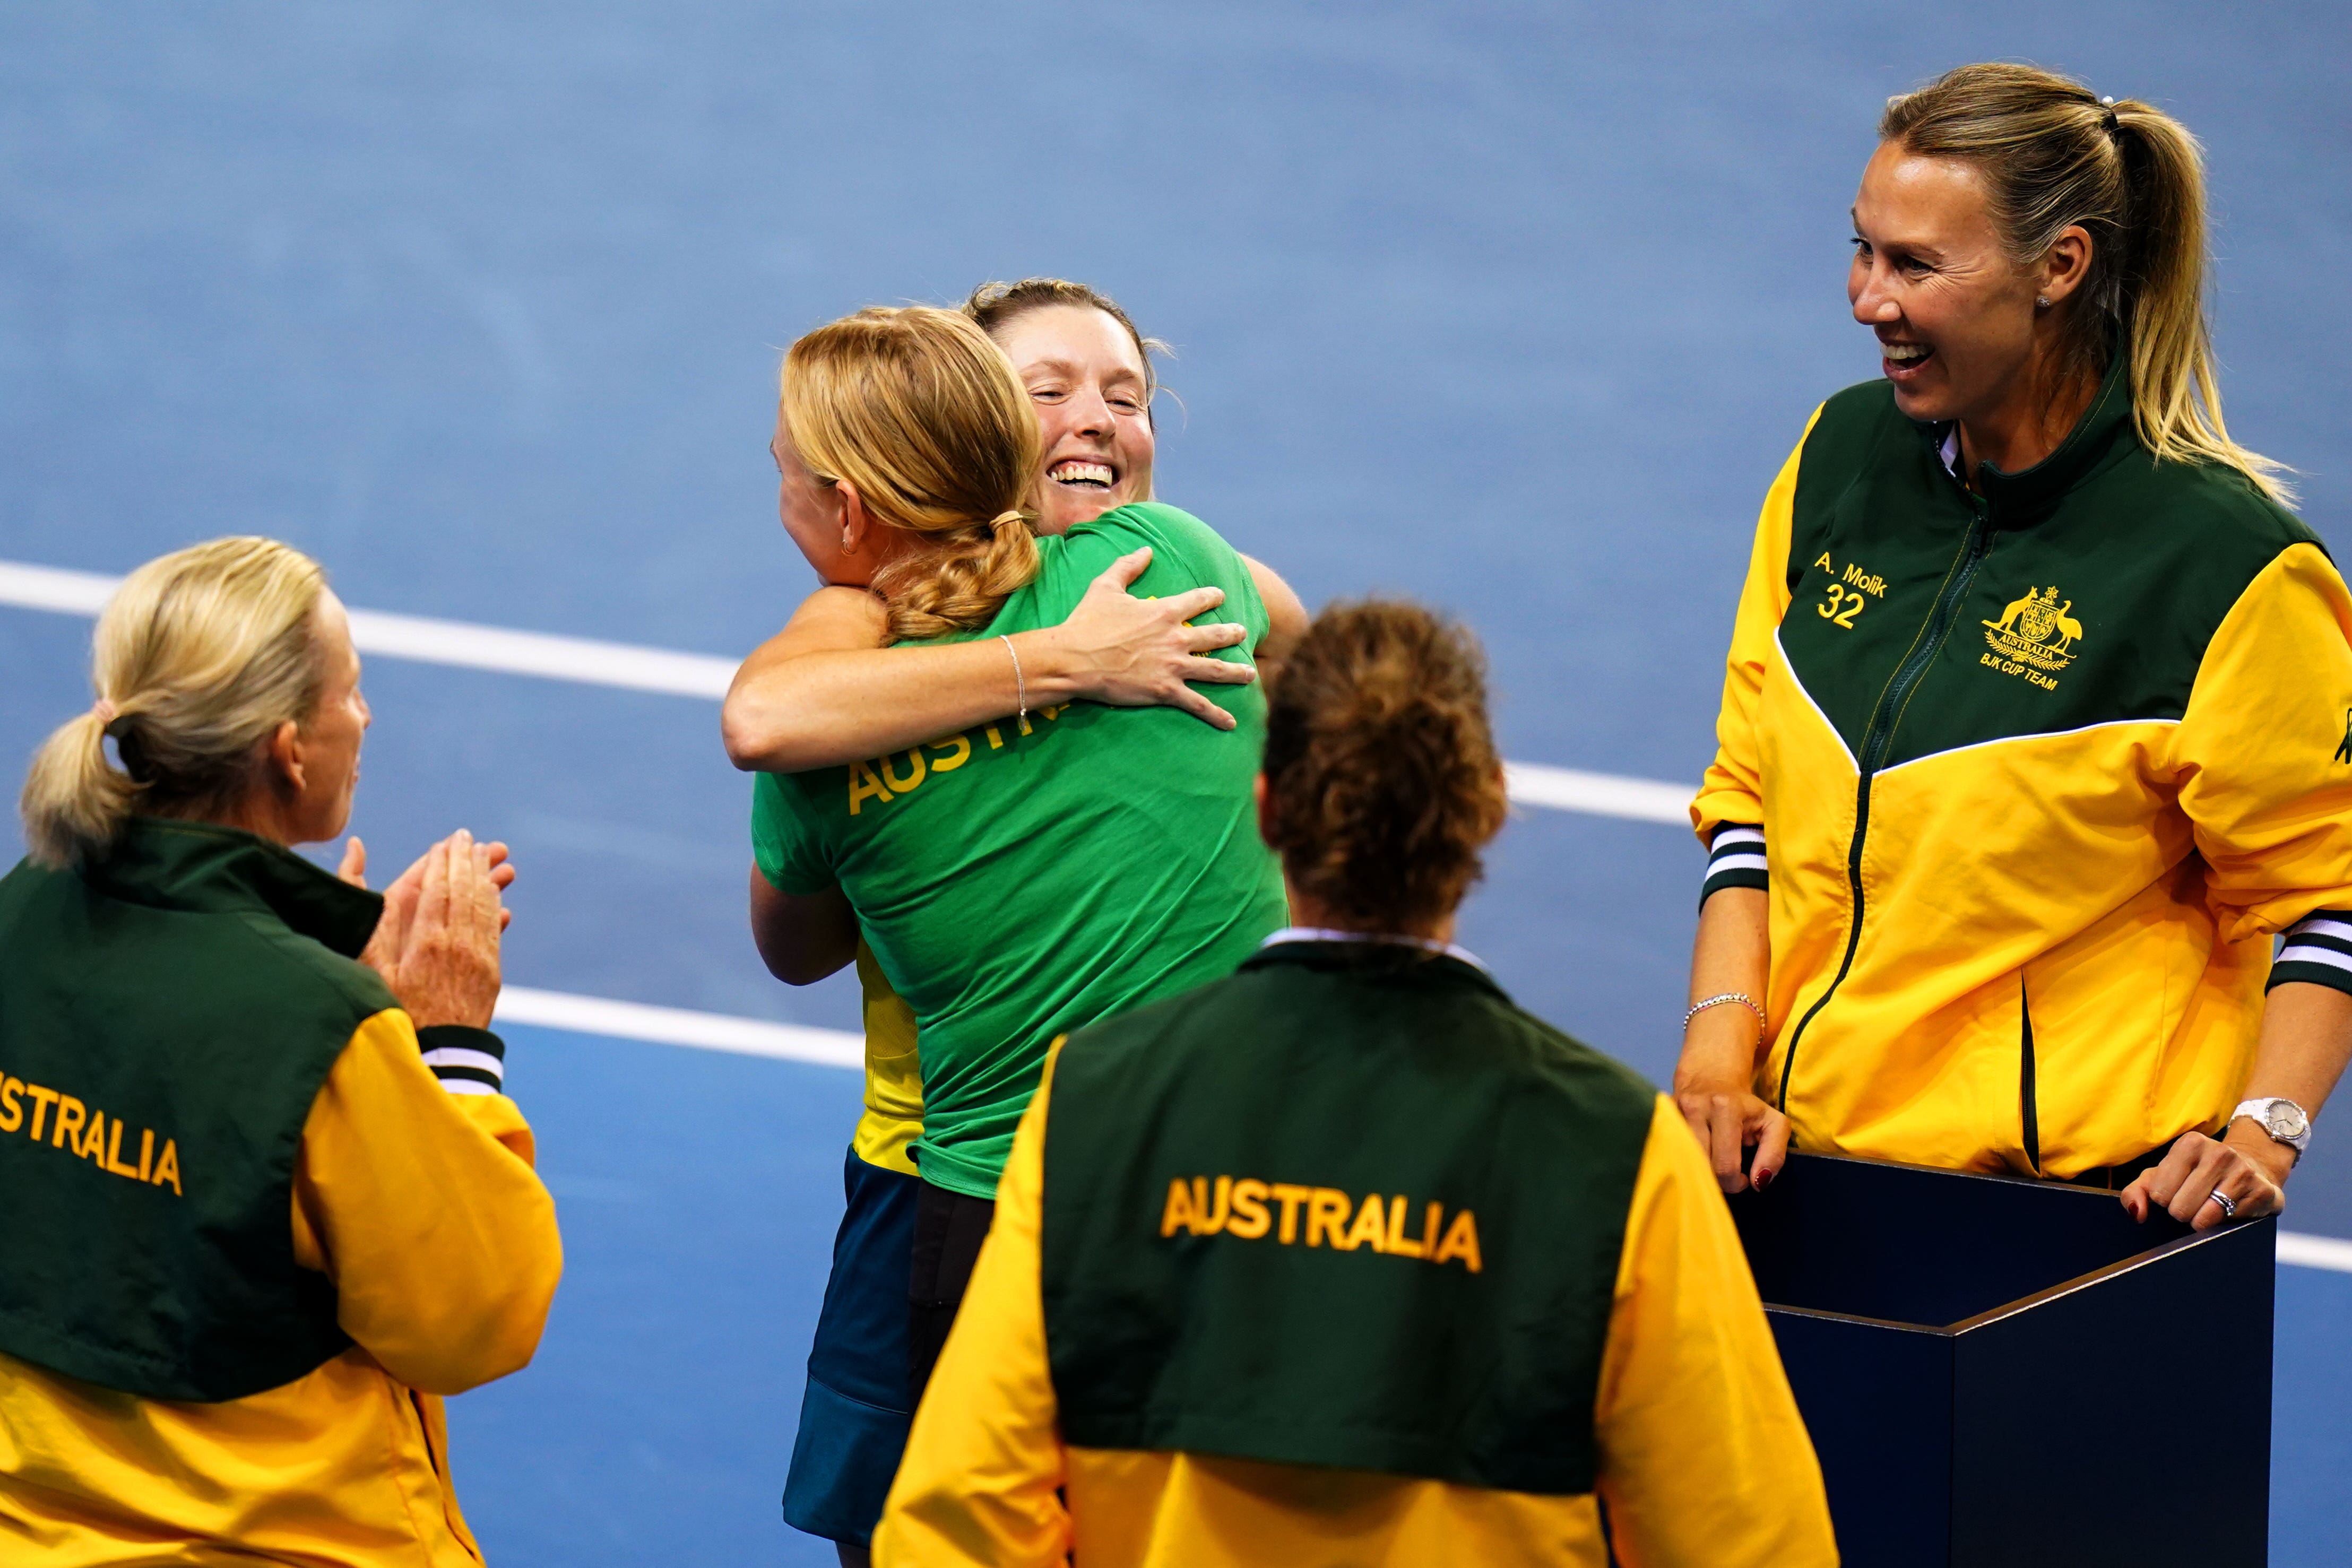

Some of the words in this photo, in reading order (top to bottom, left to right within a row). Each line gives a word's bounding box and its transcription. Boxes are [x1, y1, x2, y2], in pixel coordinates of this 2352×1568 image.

[1814, 551, 1835, 575] A.
[1842, 563, 1888, 598] Molik
[1817, 584, 1864, 629] 32
[1999, 634, 2054, 661] AUSTRALIA
[1979, 653, 2003, 670] BJK
[2002, 661, 2025, 676] CUP
[2025, 668, 2058, 691] TEAM
[0, 1071, 182, 1197] STRALIA
[1161, 1174, 1482, 1272] AUSTRALIA
